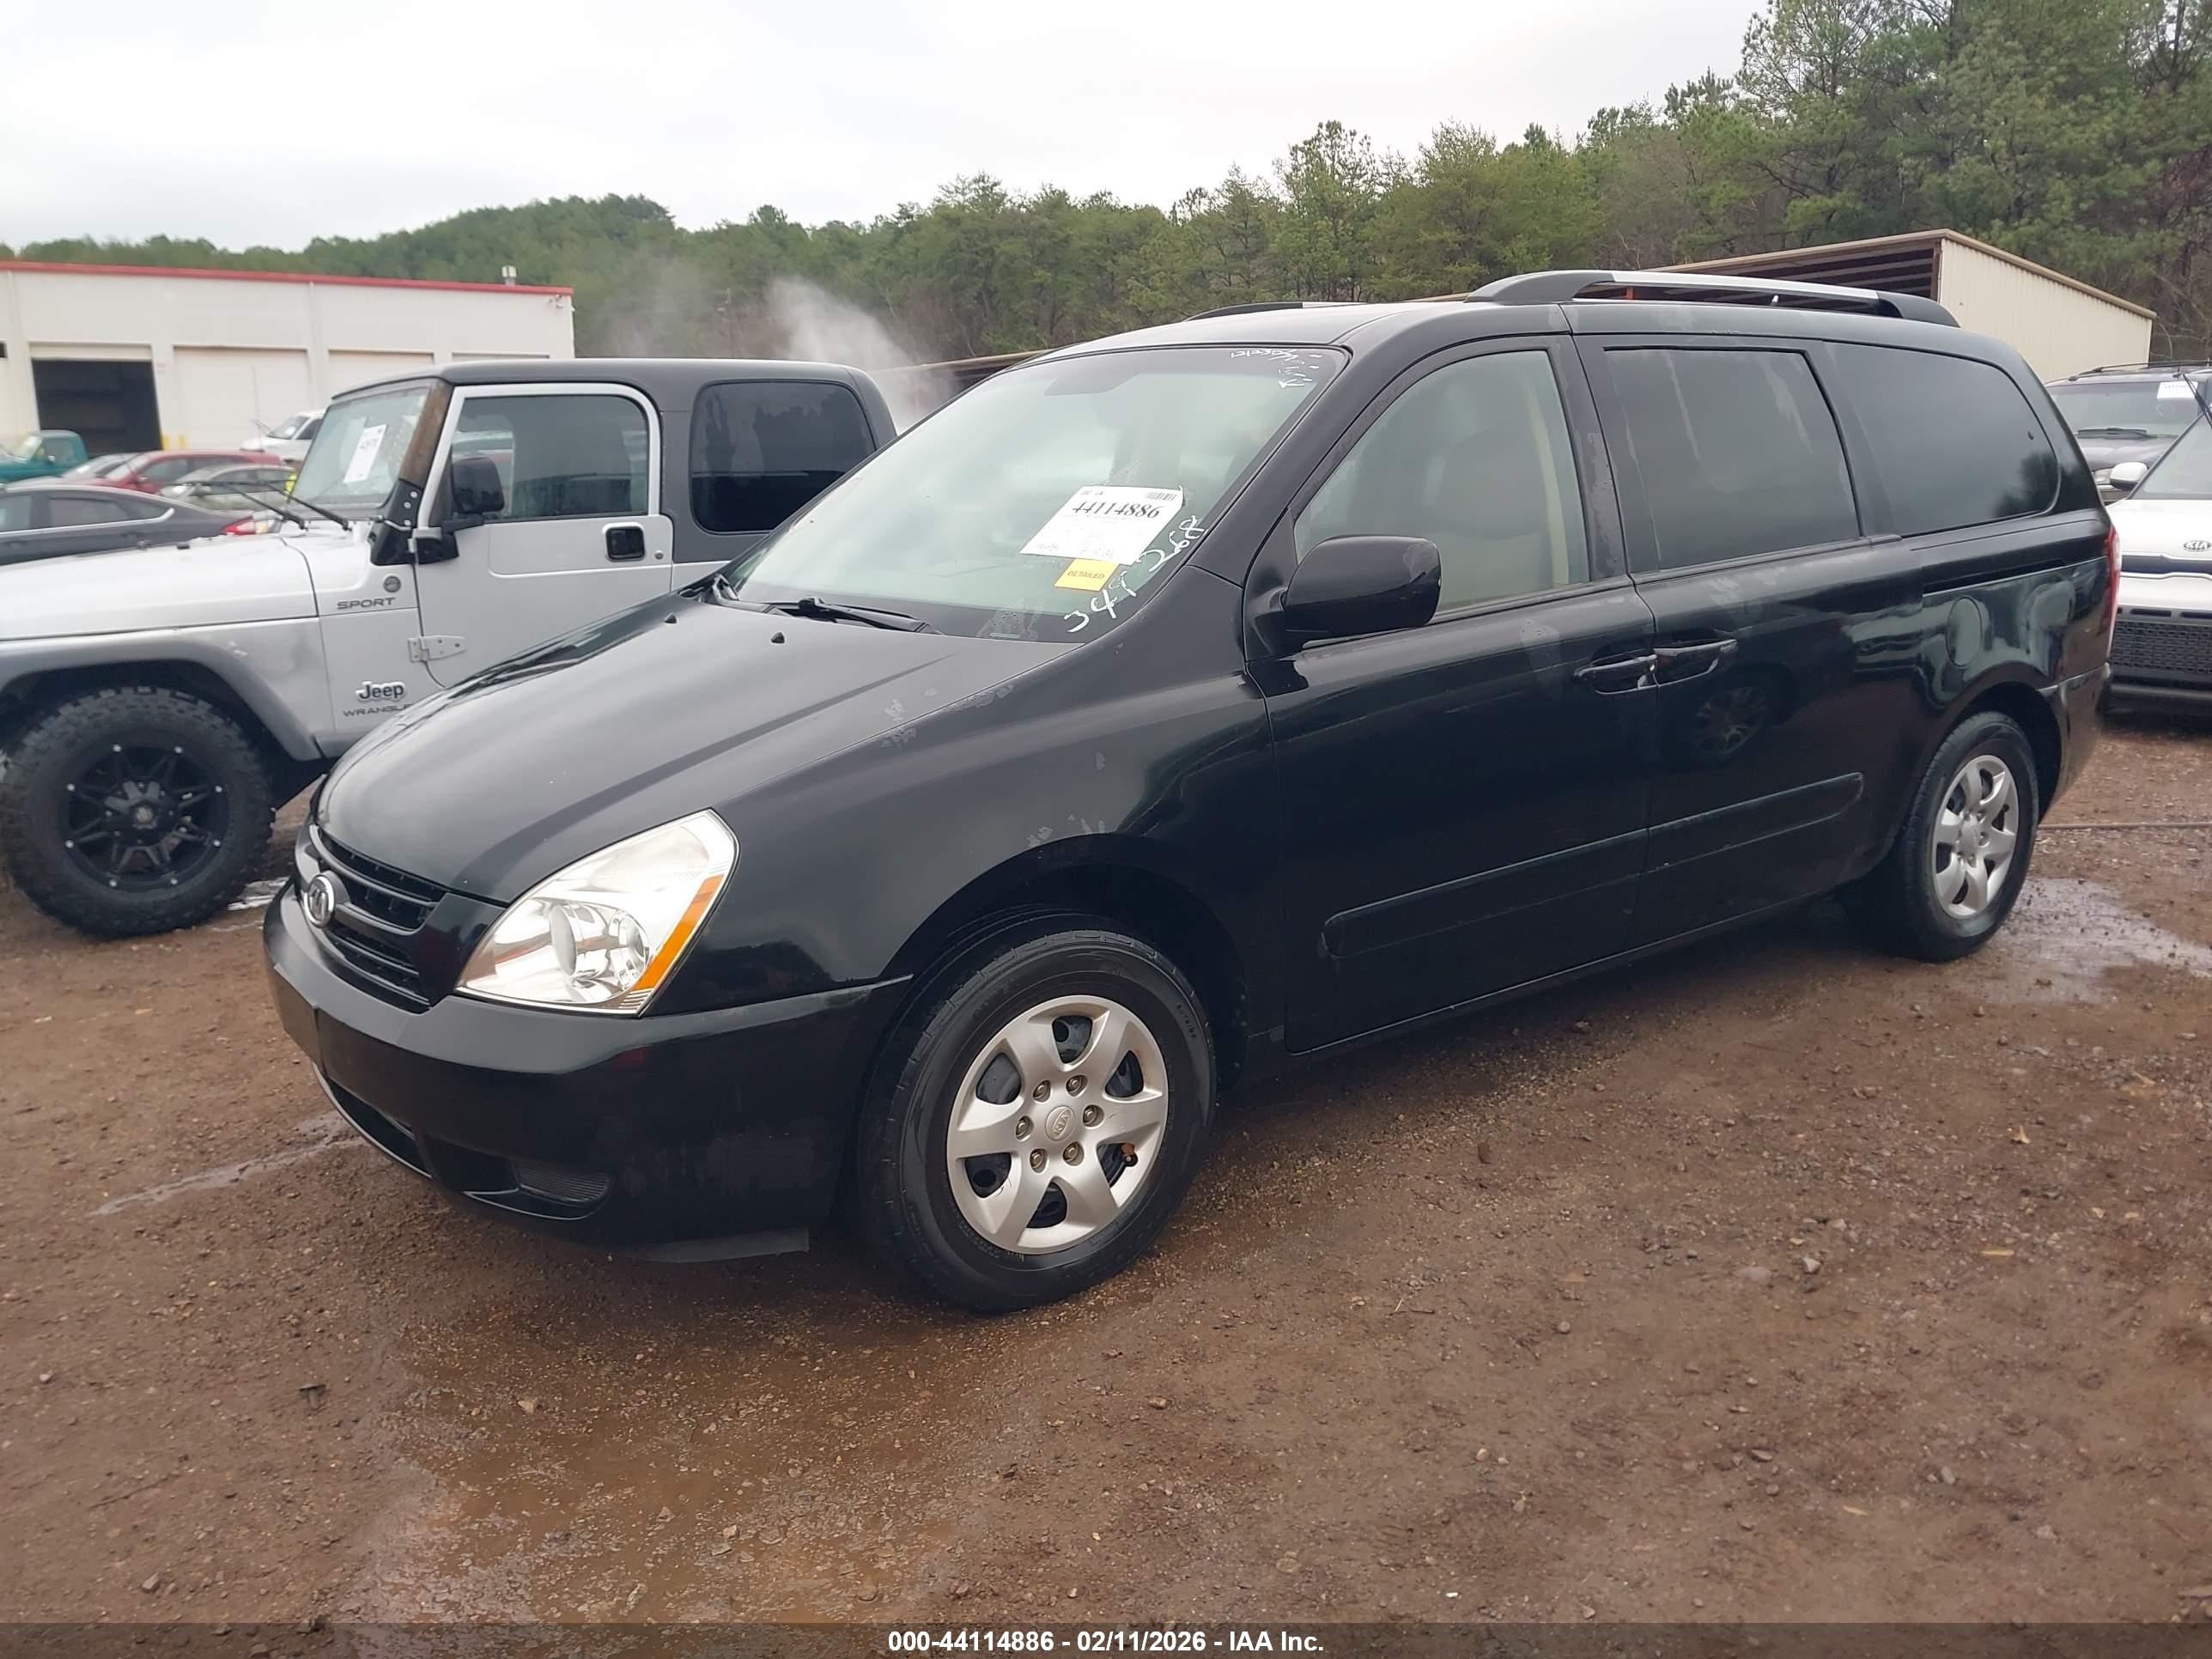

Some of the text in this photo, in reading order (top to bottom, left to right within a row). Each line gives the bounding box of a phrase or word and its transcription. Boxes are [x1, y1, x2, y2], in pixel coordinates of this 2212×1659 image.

[1073, 501, 1166, 519] 44114886
[2185, 541, 2210, 550] KIA
[1067, 570, 1105, 579] DETAILED
[337, 597, 396, 610] SPORT
[356, 681, 404, 700] Jeep
